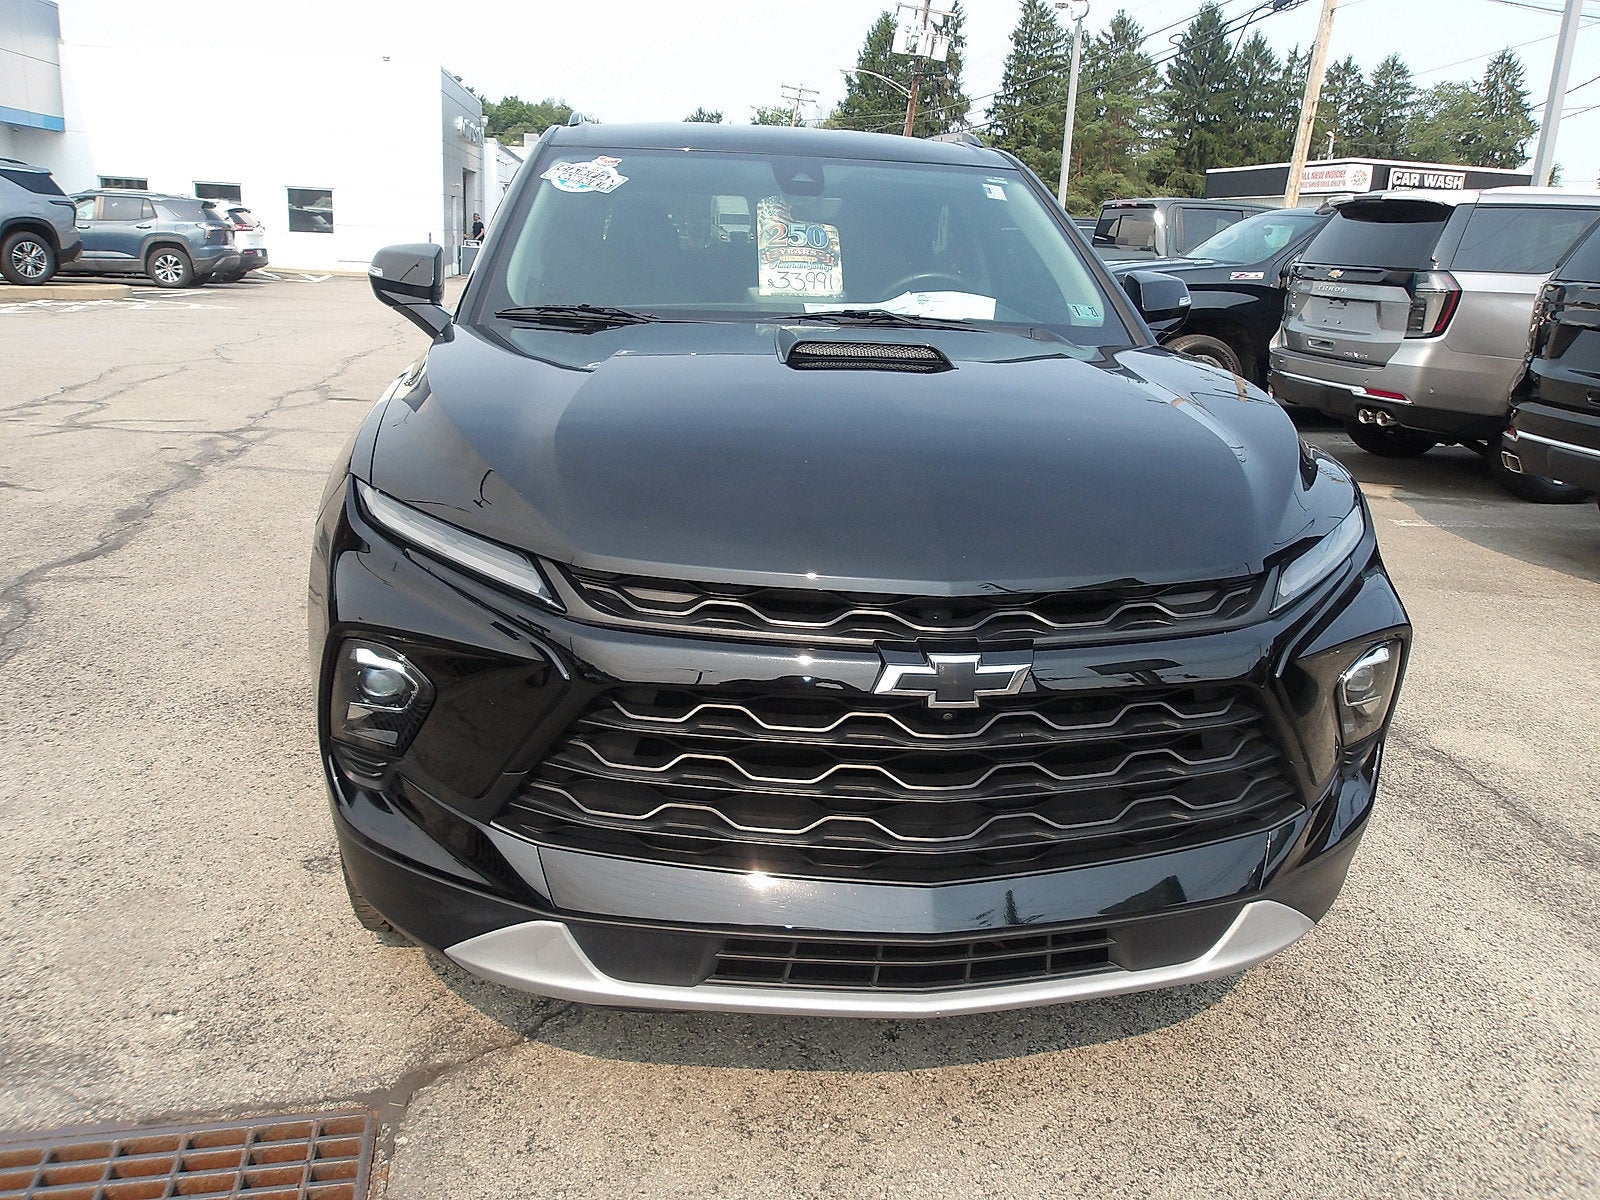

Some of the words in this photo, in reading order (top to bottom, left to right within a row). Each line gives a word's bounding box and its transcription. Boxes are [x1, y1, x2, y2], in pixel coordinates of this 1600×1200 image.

[1311, 171, 1325, 180] NEW
[1392, 171, 1420, 187] CAR
[1423, 174, 1464, 190] WASH
[768, 222, 829, 249] 250
[779, 248, 818, 257] YEARS
